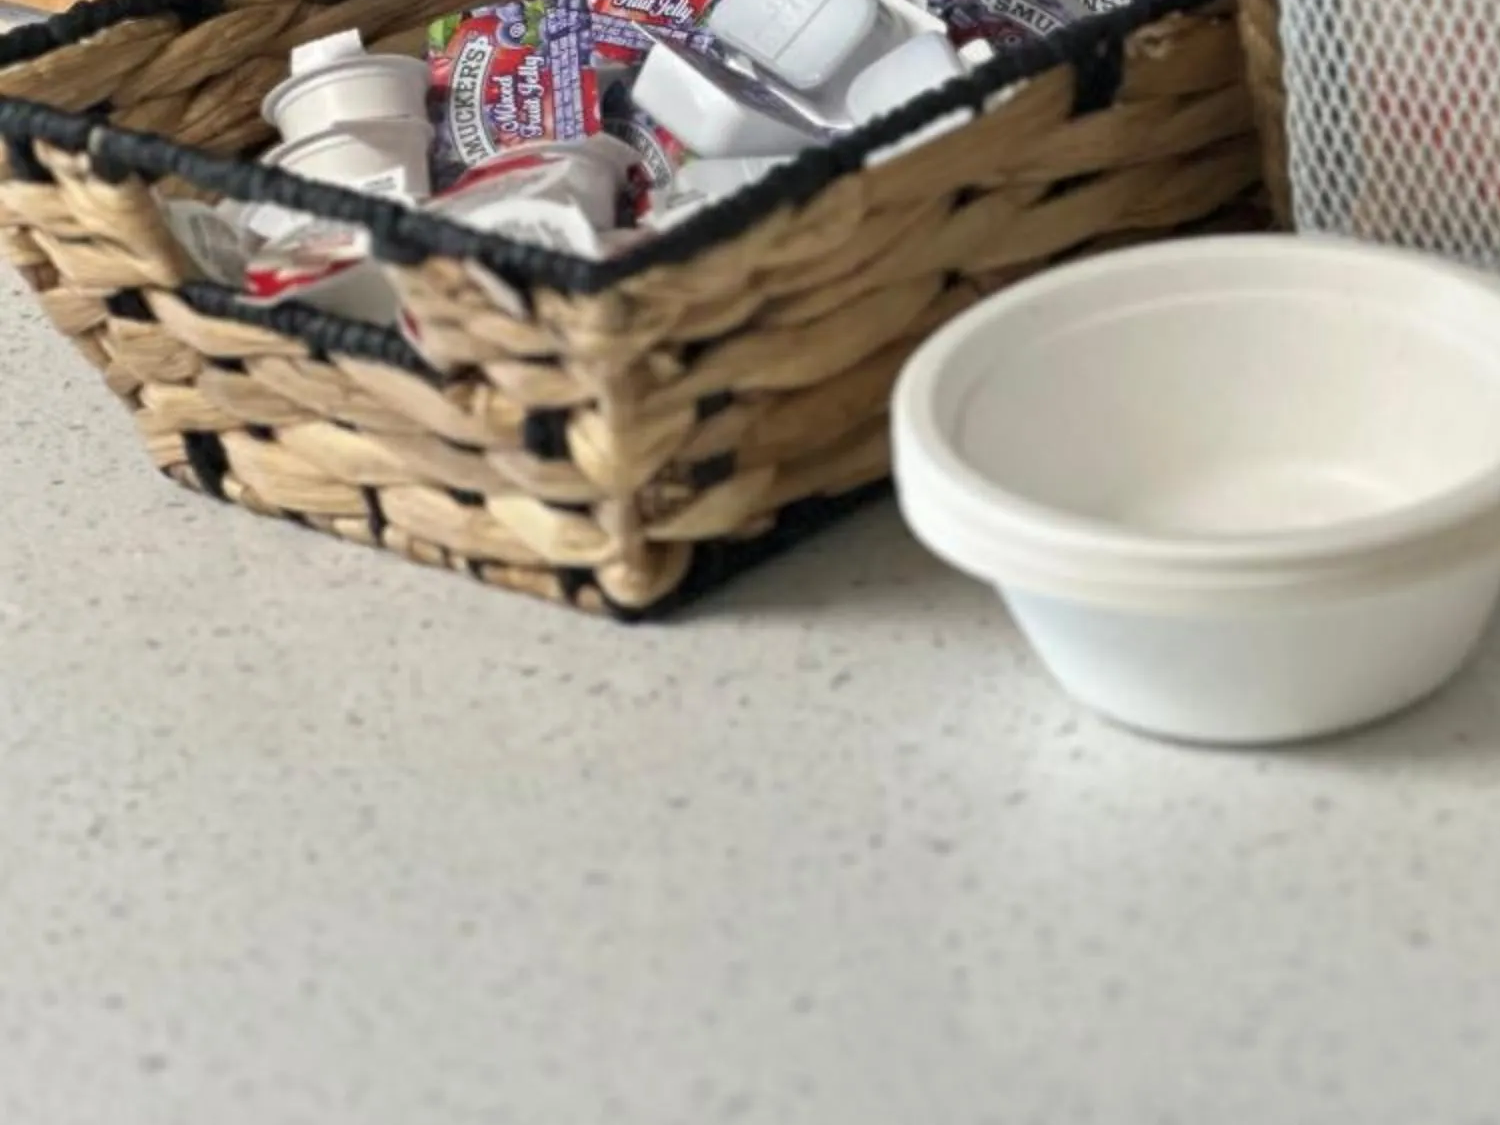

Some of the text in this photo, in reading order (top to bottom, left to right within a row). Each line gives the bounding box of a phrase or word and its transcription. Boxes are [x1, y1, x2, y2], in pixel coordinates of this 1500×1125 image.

[497, 74, 518, 133] Mixed
[517, 55, 544, 139] Fruit Jelly
